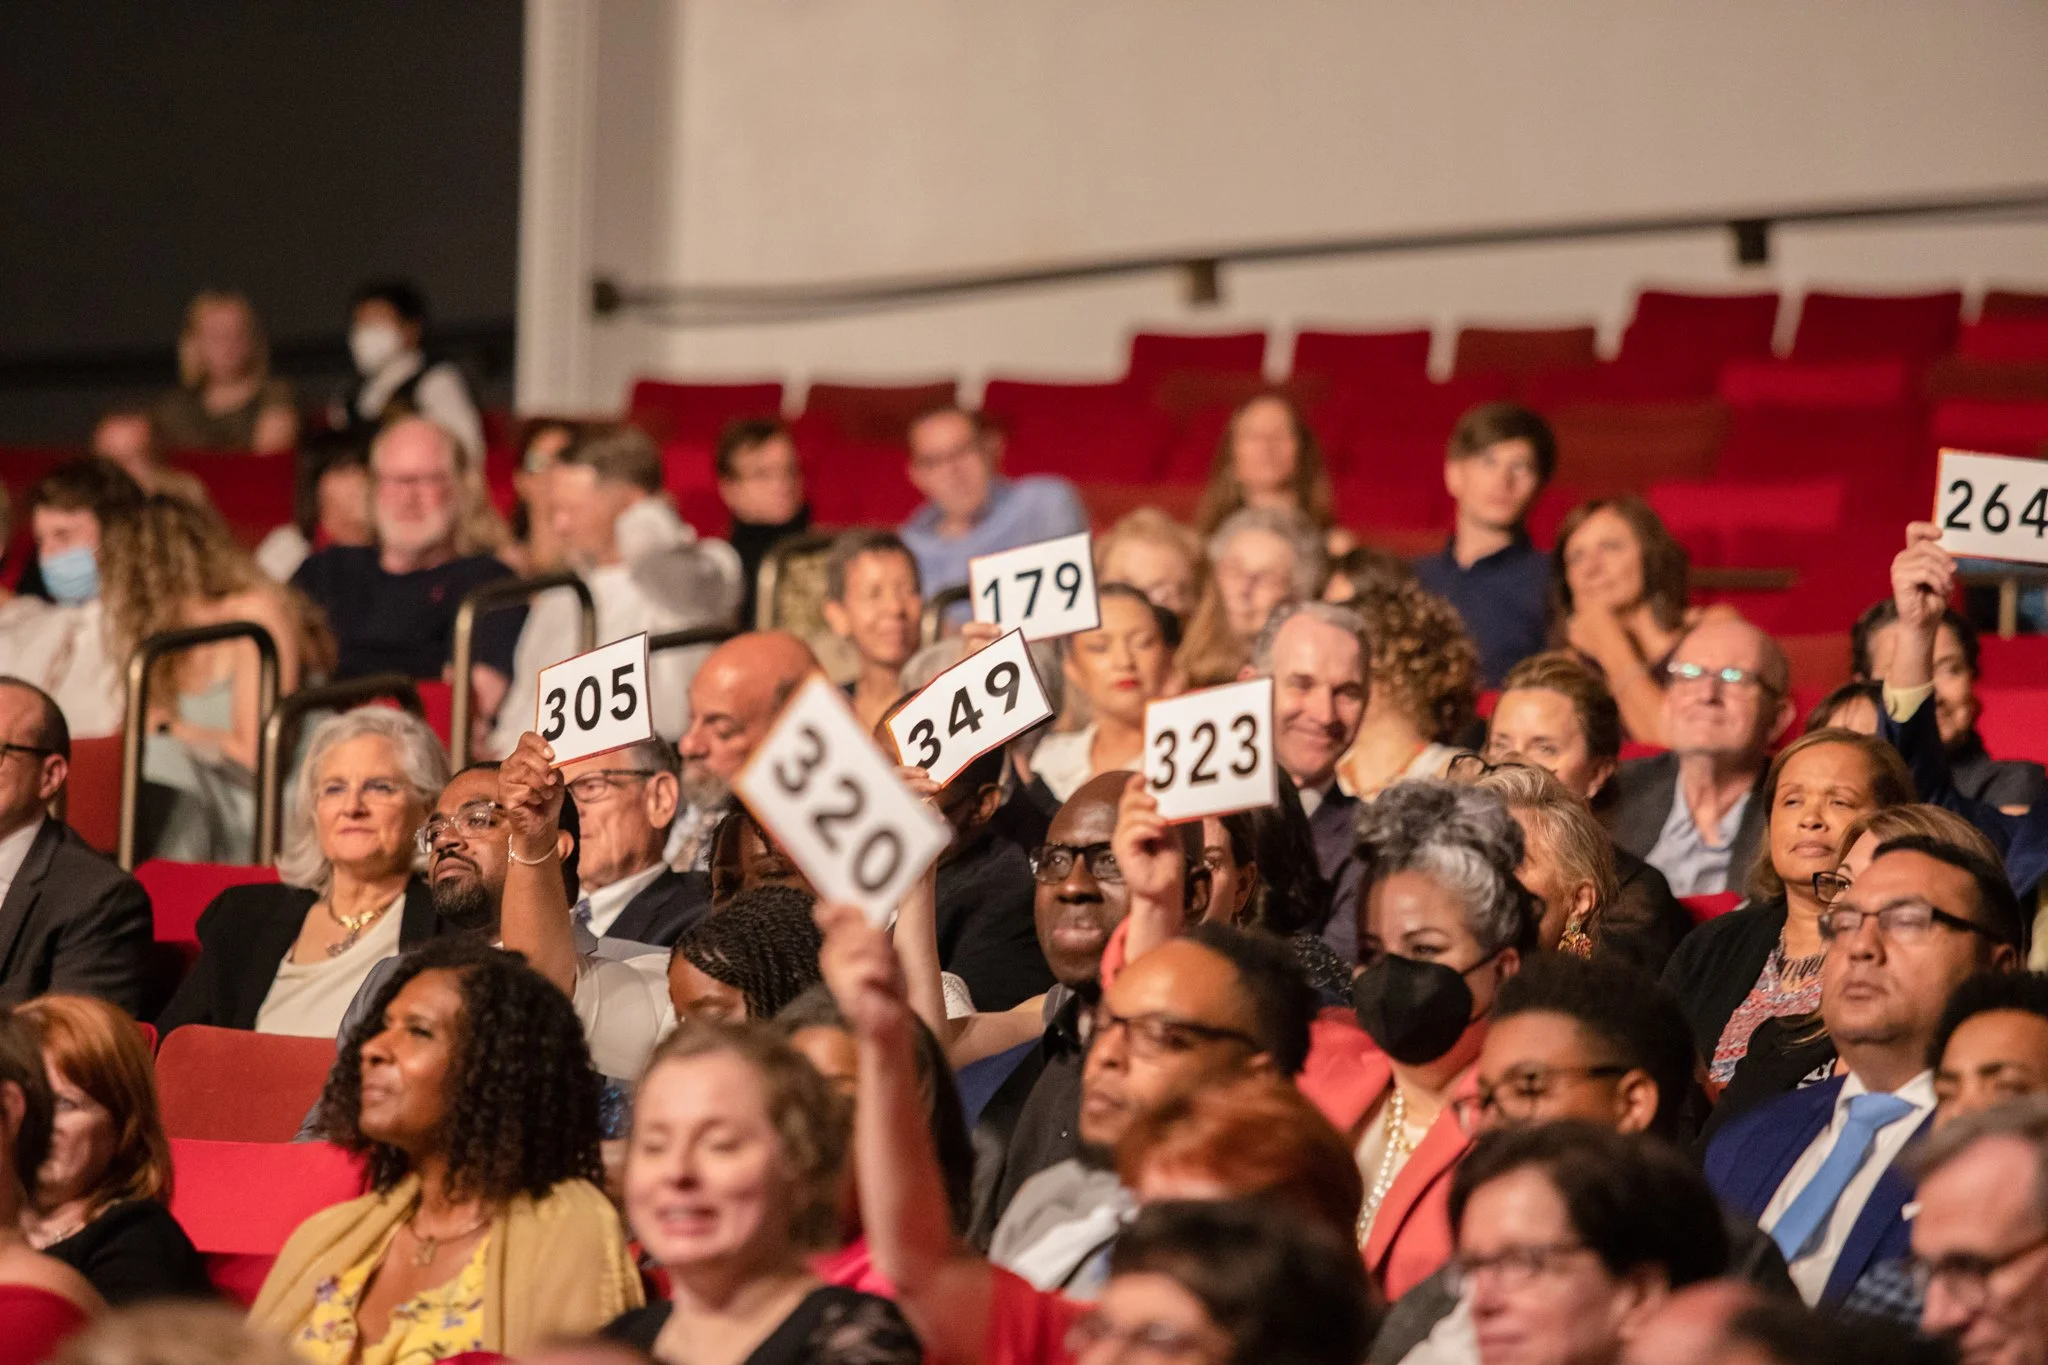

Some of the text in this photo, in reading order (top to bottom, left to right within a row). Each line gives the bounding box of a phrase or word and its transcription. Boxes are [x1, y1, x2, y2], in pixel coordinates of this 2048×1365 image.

[1944, 480, 2048, 538] 264
[982, 561, 1081, 624] 179
[542, 662, 637, 742] 305
[908, 660, 1021, 769] 349
[1151, 713, 1259, 792] 323
[775, 726, 906, 894] 320
